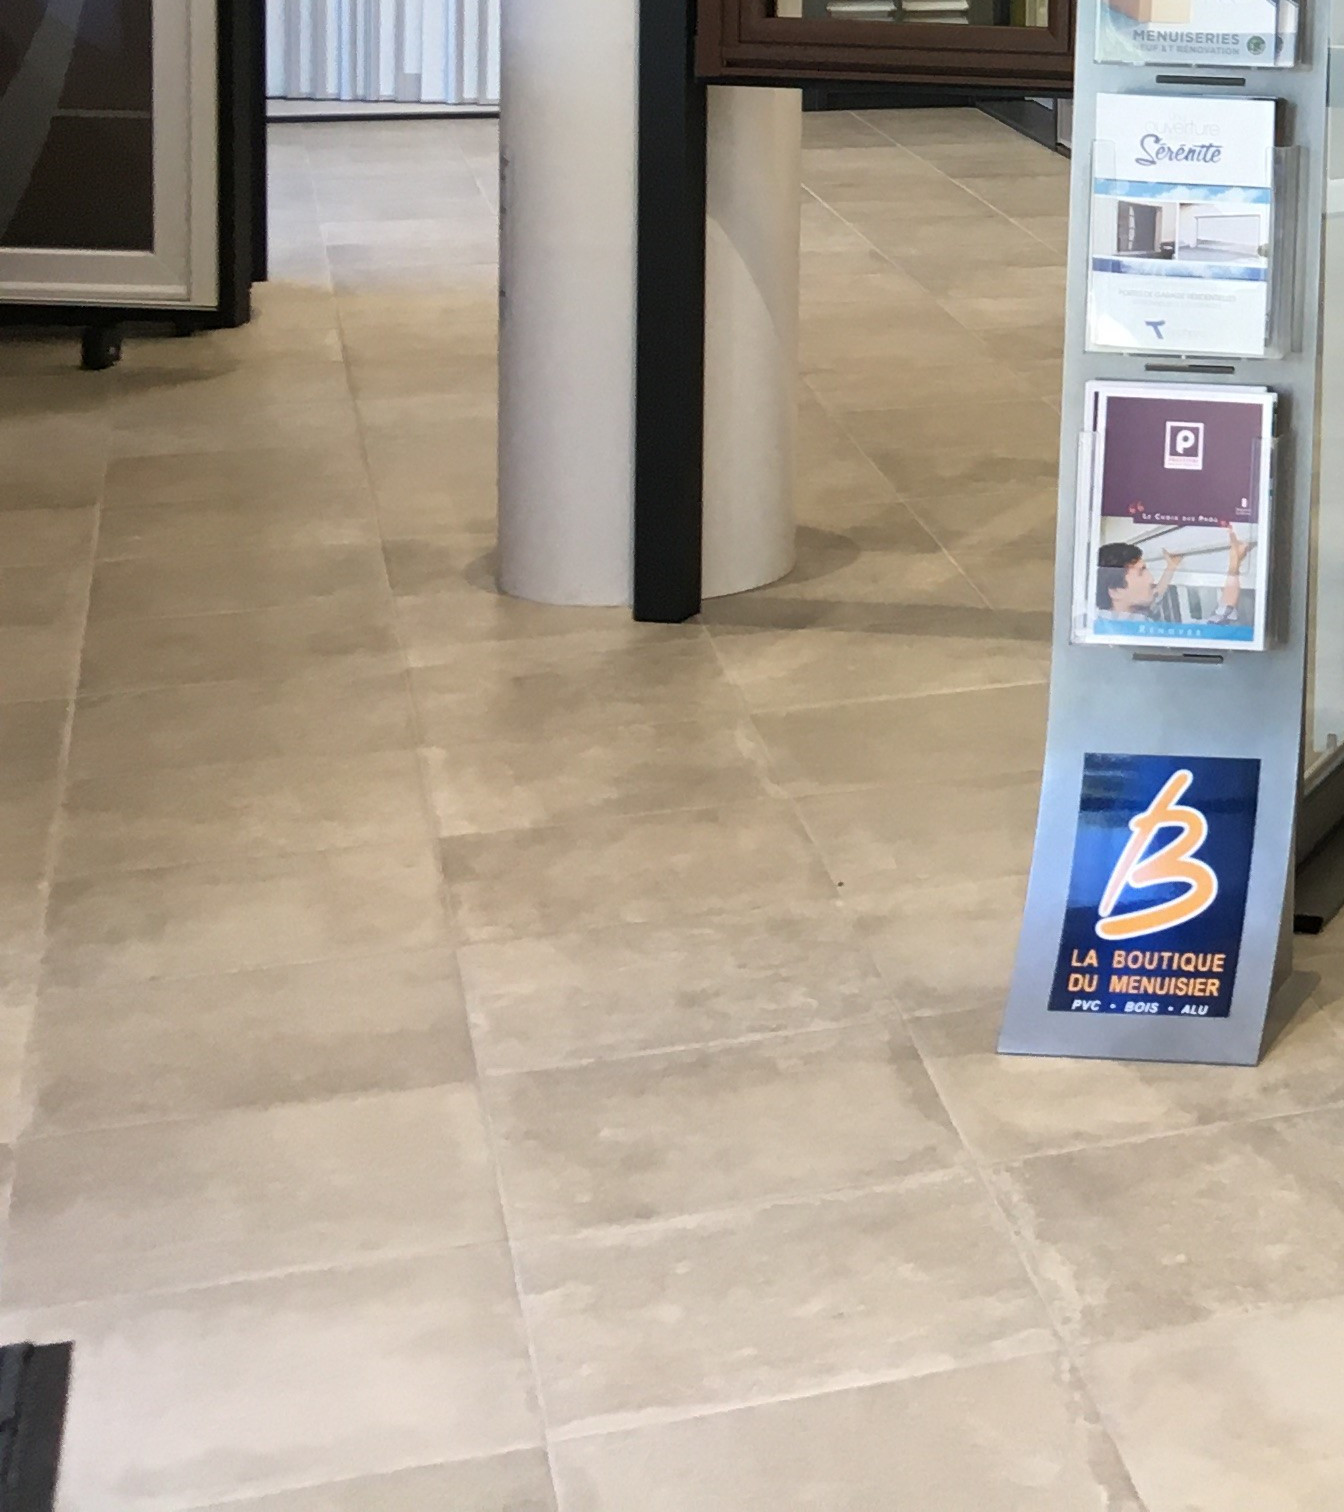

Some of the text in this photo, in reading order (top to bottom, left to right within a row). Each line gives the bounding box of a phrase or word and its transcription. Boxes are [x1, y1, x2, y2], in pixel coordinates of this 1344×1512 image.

[1133, 30, 1239, 44] MENUISERIES
[1071, 949, 1226, 972] LA BOUTIQUE
[1067, 973, 1220, 997] DU MENUISIER
[1071, 999, 1208, 1015] PVC BOIS ALU
